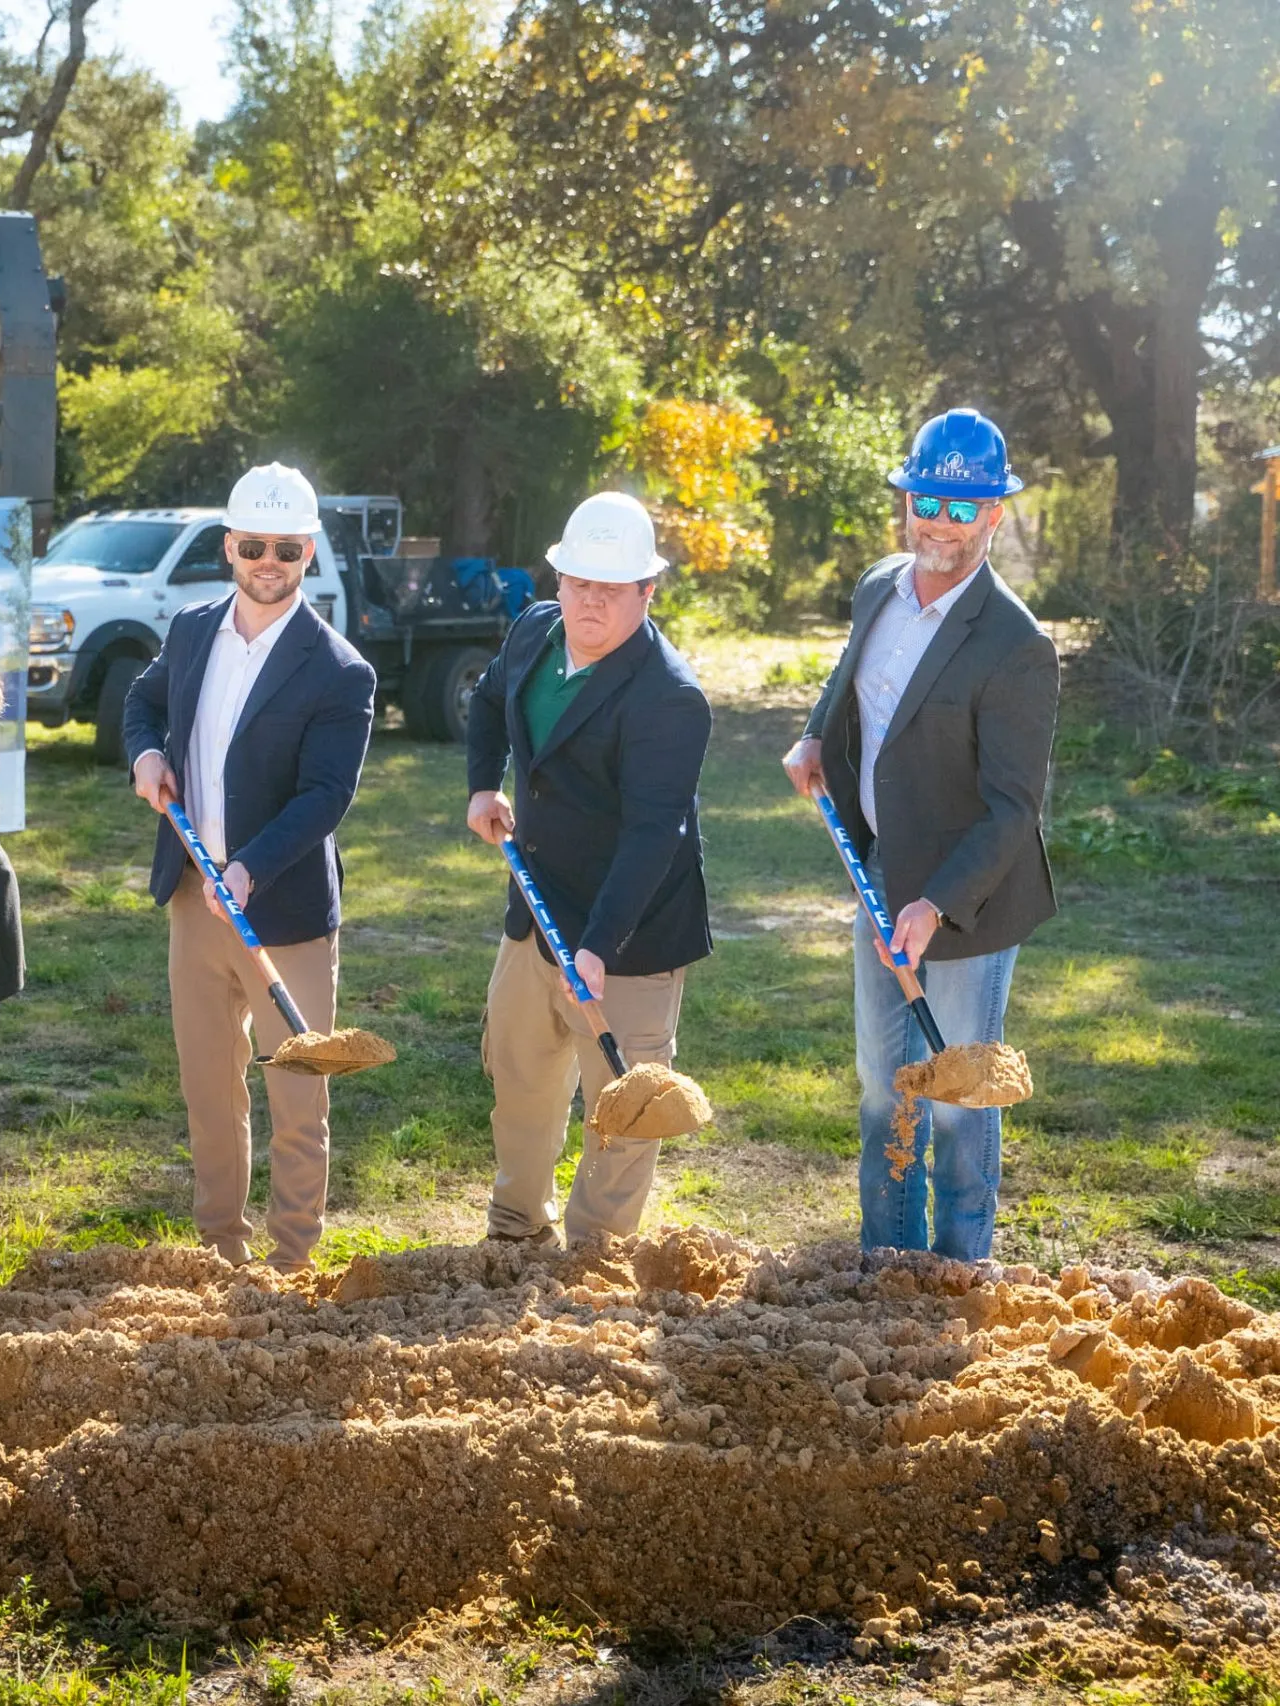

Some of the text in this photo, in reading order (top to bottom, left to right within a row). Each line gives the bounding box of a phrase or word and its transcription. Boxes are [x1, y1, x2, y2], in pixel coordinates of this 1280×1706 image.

[255, 501, 289, 510] ELITE
[935, 466, 970, 478] ELITE
[185, 829, 243, 915] ELITE
[834, 827, 892, 929] ELITE
[518, 870, 576, 967] ELITE
